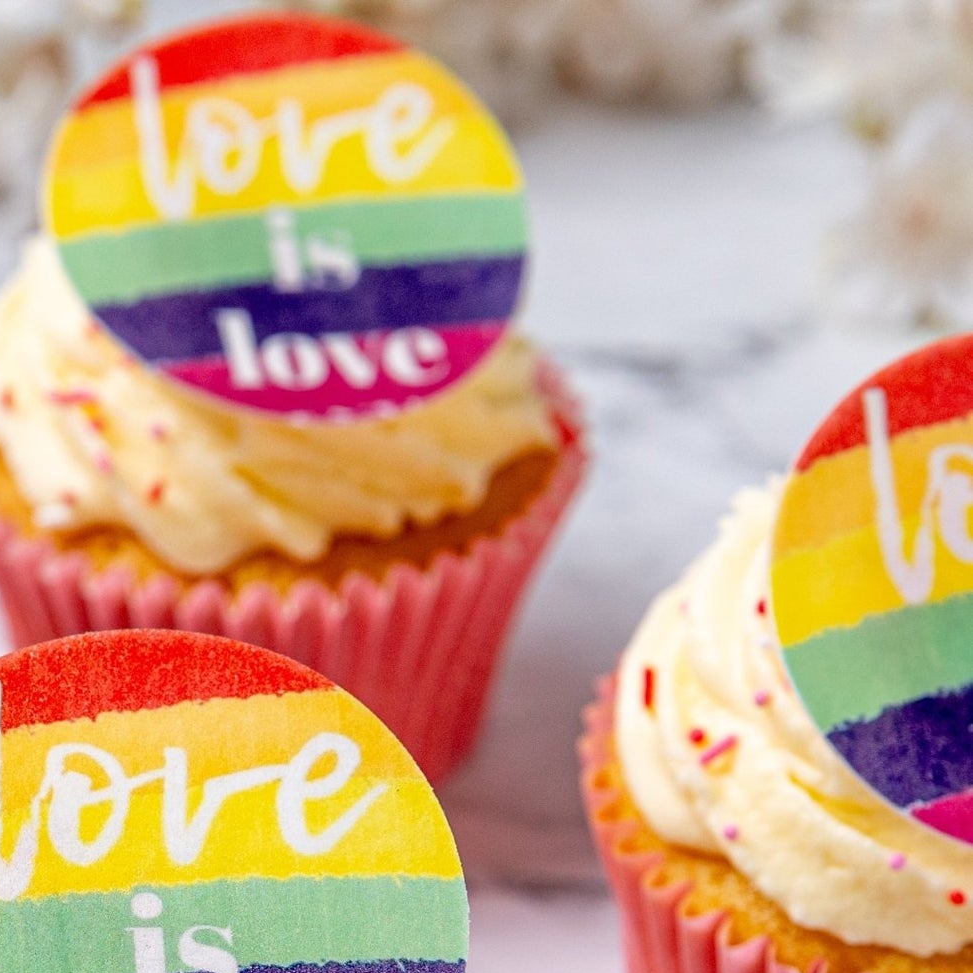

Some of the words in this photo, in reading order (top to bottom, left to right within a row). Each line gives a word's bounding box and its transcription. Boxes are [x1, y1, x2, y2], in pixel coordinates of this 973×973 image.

[129, 55, 458, 221] love
[265, 207, 361, 292] is
[215, 307, 451, 391] love
